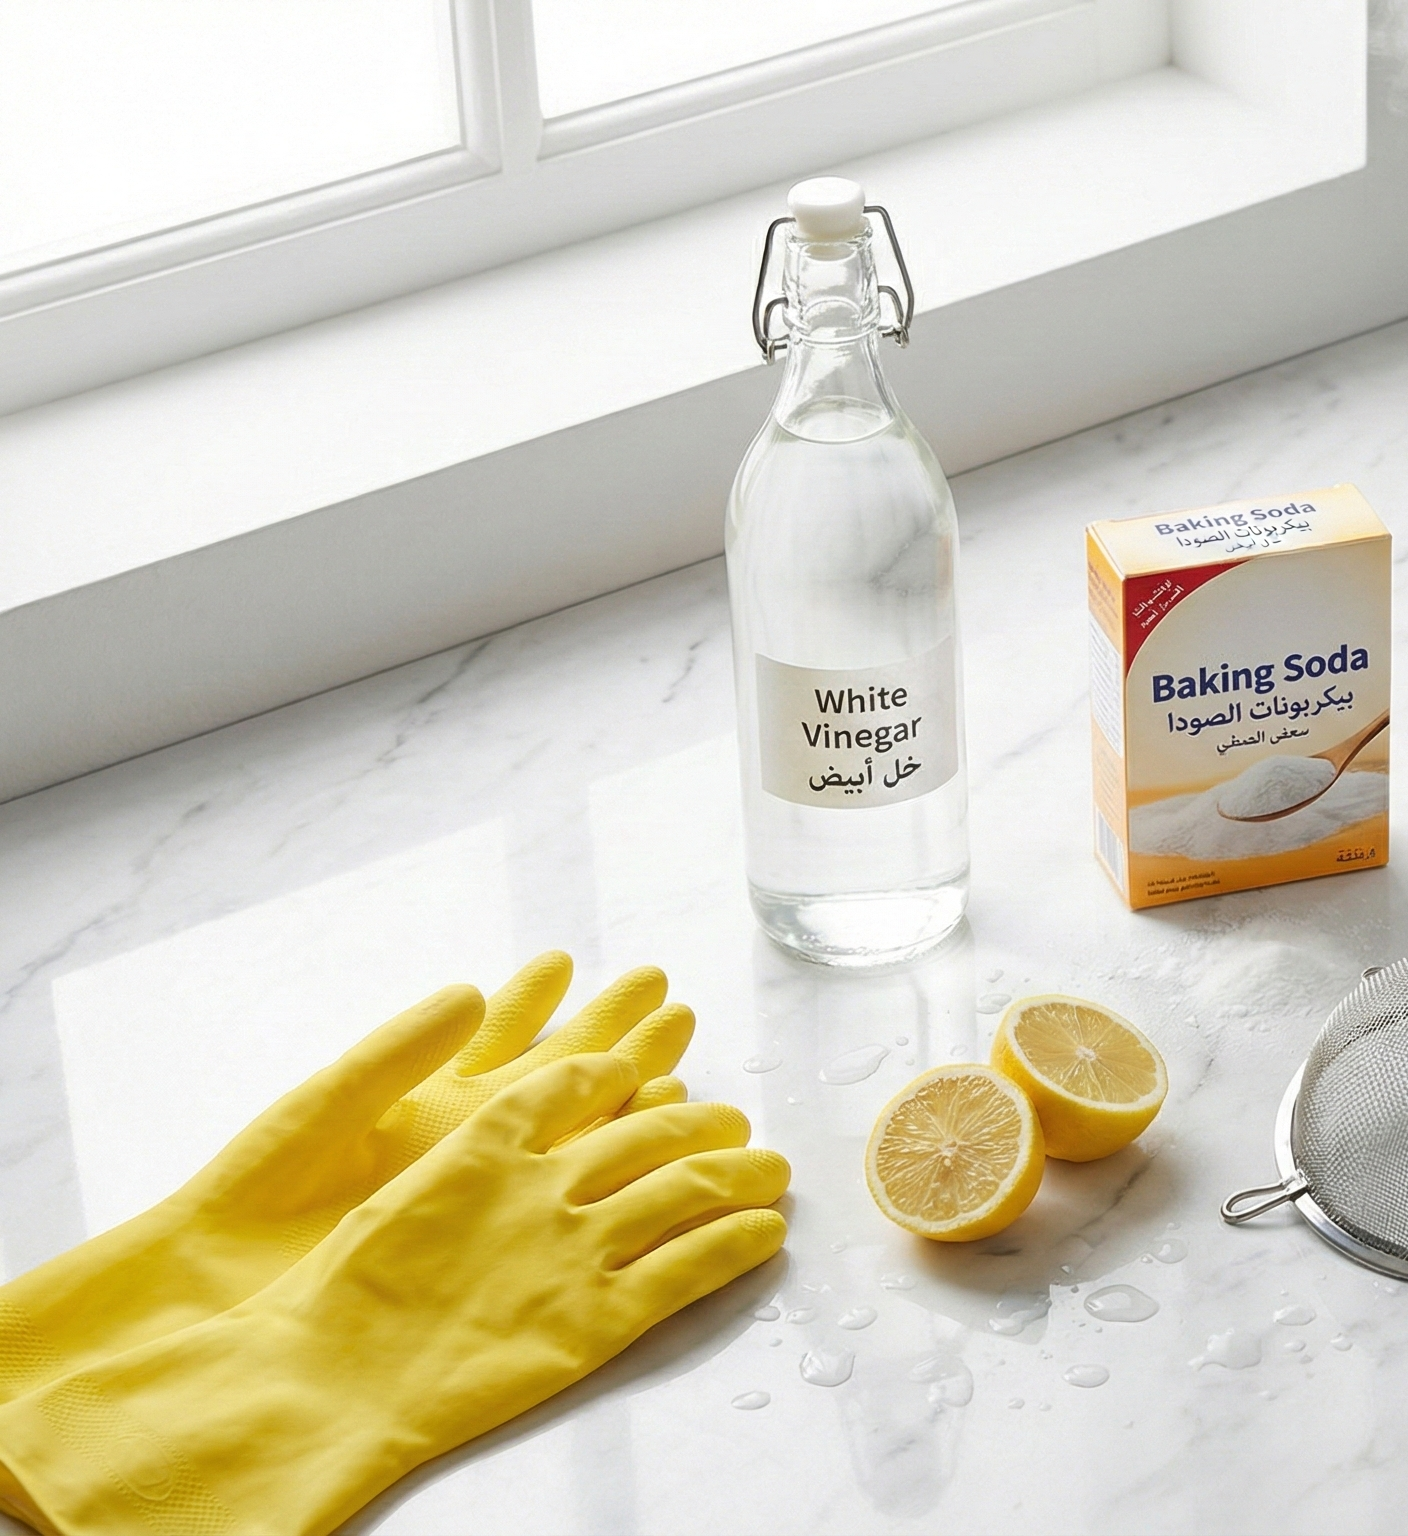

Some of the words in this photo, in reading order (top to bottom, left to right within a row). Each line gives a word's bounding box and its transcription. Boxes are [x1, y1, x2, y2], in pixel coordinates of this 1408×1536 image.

[1155, 513, 1248, 536] Baking
[1250, 502, 1317, 521] Soda
[1176, 529, 1231, 548] الصودا
[1152, 663, 1276, 703] Baking
[1283, 644, 1369, 682] Soda
[814, 686, 908, 714] White
[1249, 685, 1354, 720] بيكربونات
[801, 716, 922, 753] Vinegar
[1167, 702, 1242, 736] الصودا
[809, 757, 873, 794] أبيض
[883, 756, 922, 788] خل
